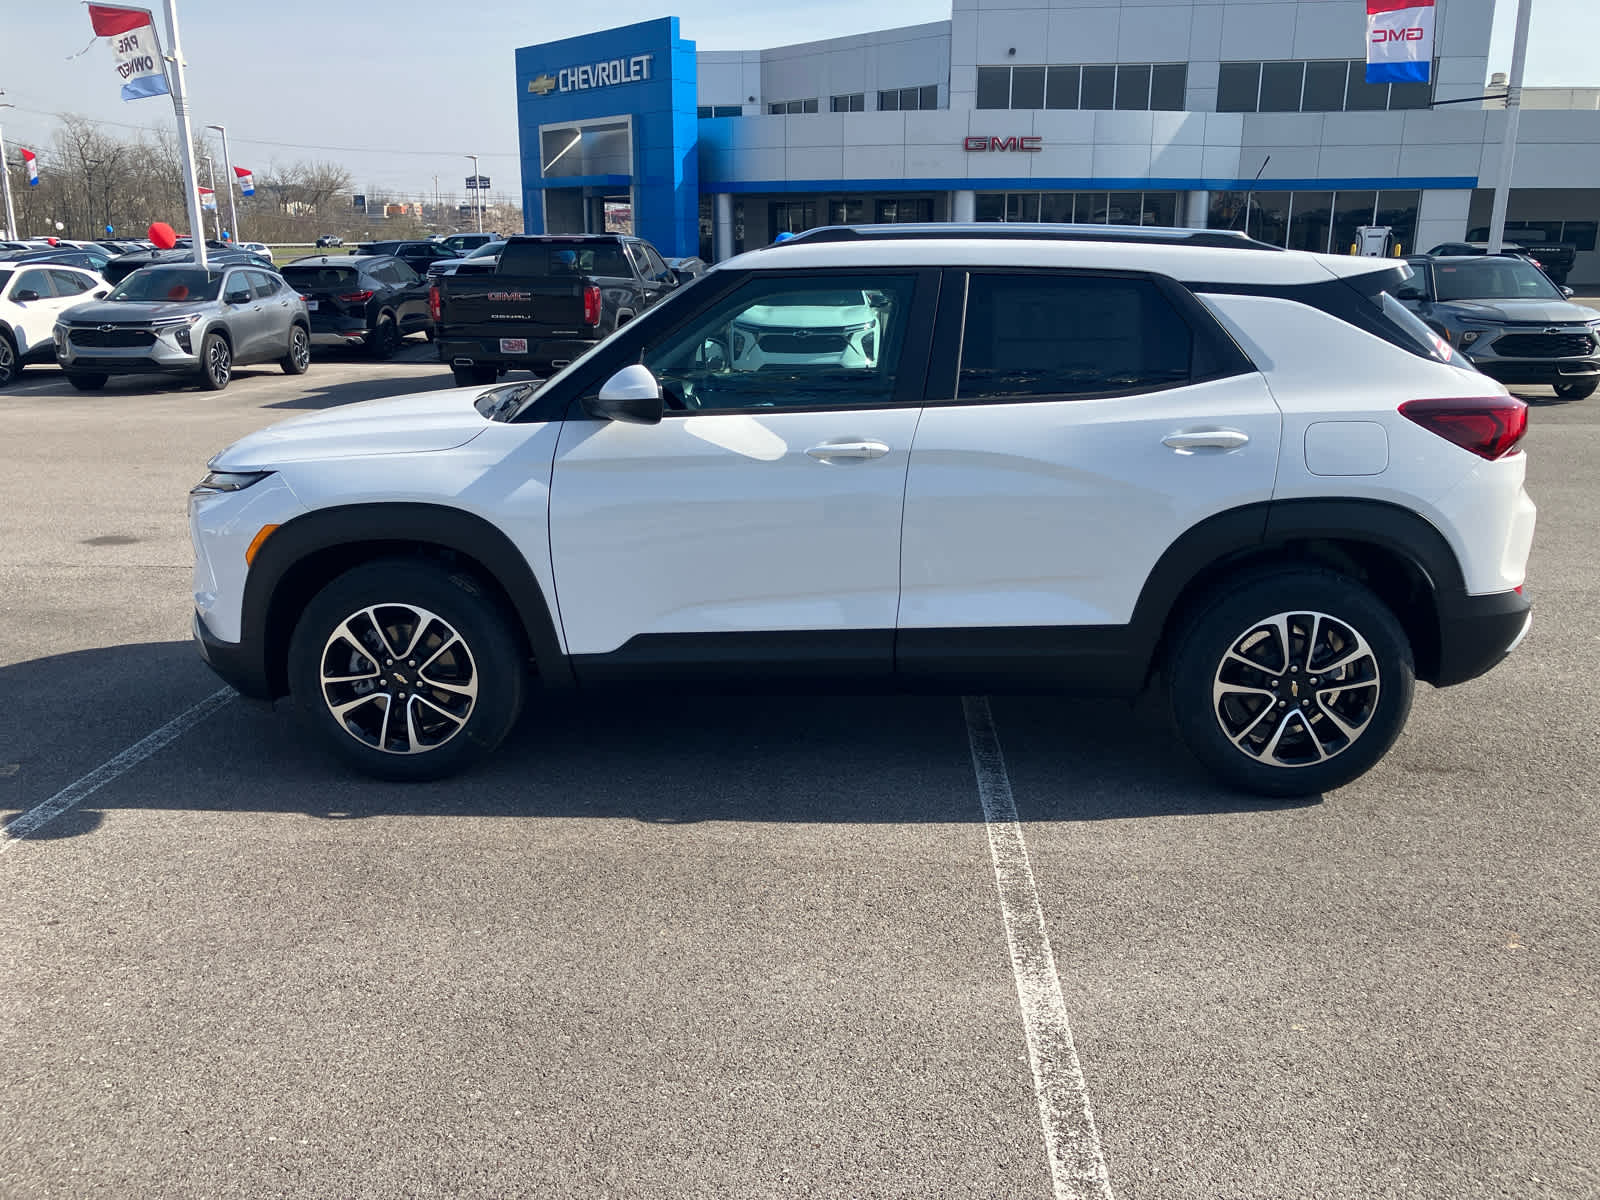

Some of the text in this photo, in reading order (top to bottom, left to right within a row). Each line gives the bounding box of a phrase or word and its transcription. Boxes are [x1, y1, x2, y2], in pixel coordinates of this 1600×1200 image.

[558, 54, 652, 92] CHEVROLET
[963, 135, 1043, 152] GMC
[487, 291, 531, 301] GMC
